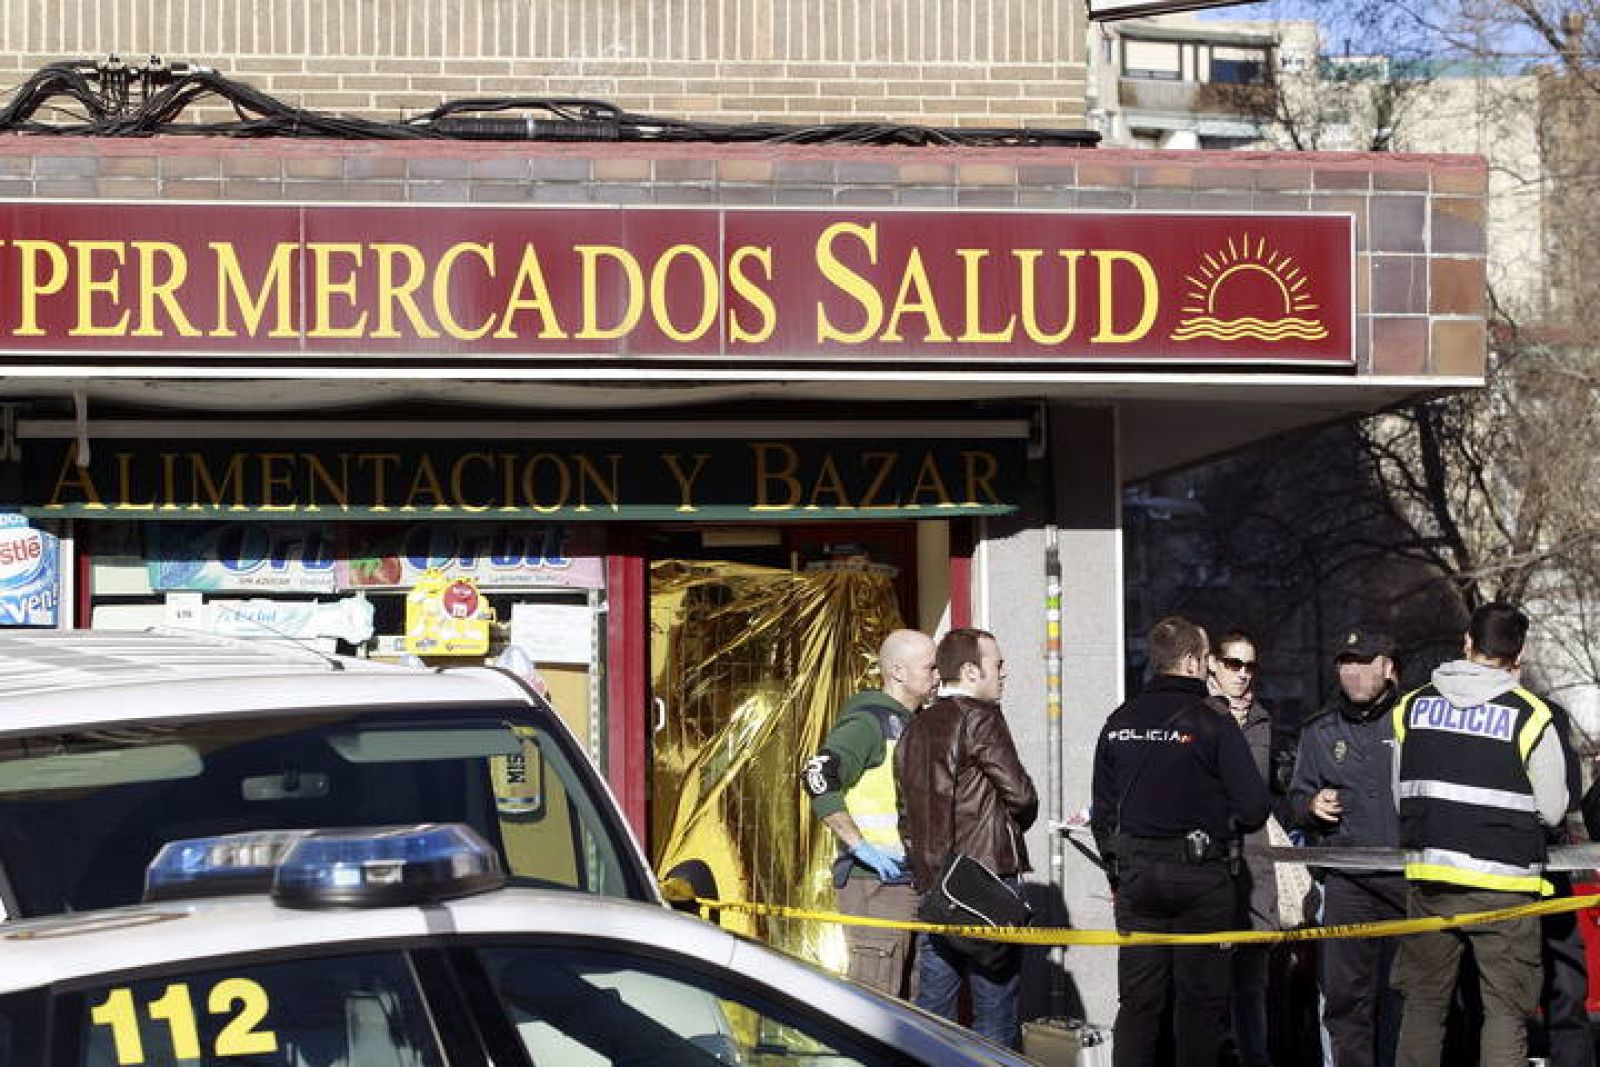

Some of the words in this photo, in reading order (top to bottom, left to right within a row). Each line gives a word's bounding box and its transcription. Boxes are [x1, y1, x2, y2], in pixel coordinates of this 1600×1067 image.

[0, 238, 777, 344] PERMERCADOS
[815, 222, 1160, 345] SALUD
[43, 440, 625, 512] ALIMENTACION
[659, 453, 712, 512] Y
[749, 442, 1003, 511] BAZAR
[1108, 728, 1181, 741] POLICIA
[1413, 699, 1511, 738] POLICIA
[91, 977, 279, 1066] 112
